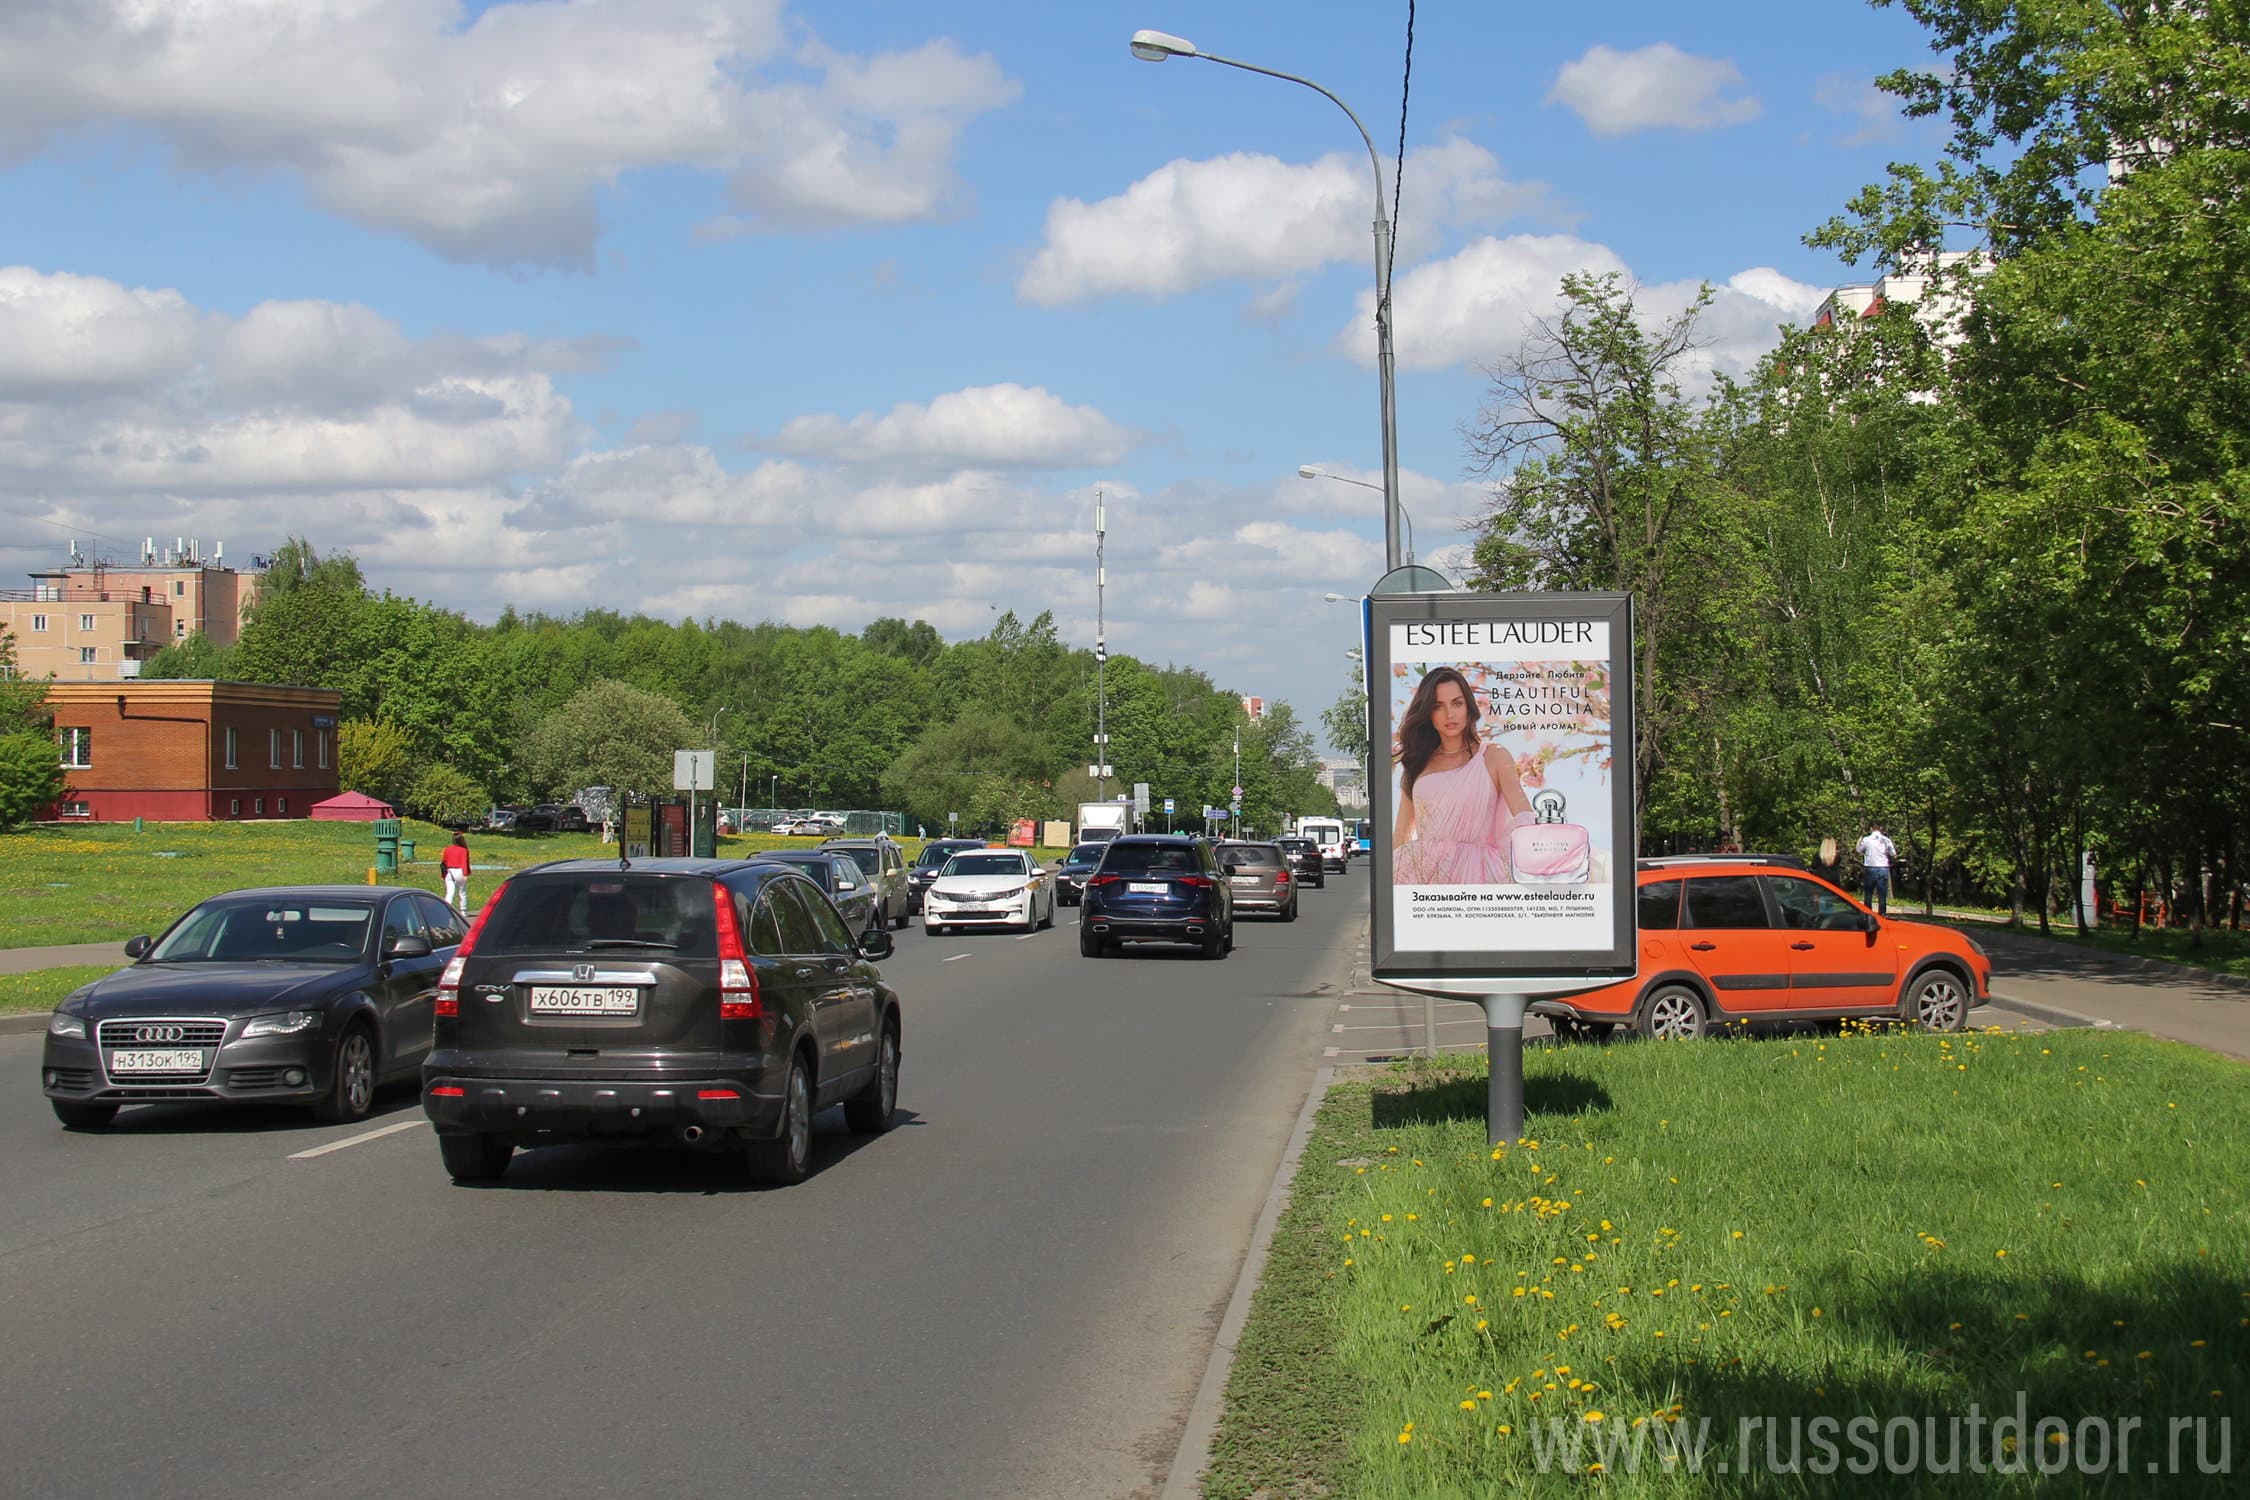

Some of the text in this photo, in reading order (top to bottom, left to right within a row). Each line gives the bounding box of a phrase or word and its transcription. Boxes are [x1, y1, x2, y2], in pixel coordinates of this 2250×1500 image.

[1490, 621, 1593, 643] LAUDER
[1496, 670, 1588, 680] Дерзайте. Любите.
[1491, 686, 1590, 699] BEAUTIFUL
[1489, 703, 1593, 715] MAGNOLIA
[1503, 722, 1537, 731] НОВЫЙ
[1412, 891, 1477, 901] Заказывайте
[1496, 889, 1595, 900] www.esteelauder.ru
[607, 990, 633, 1004] 199
